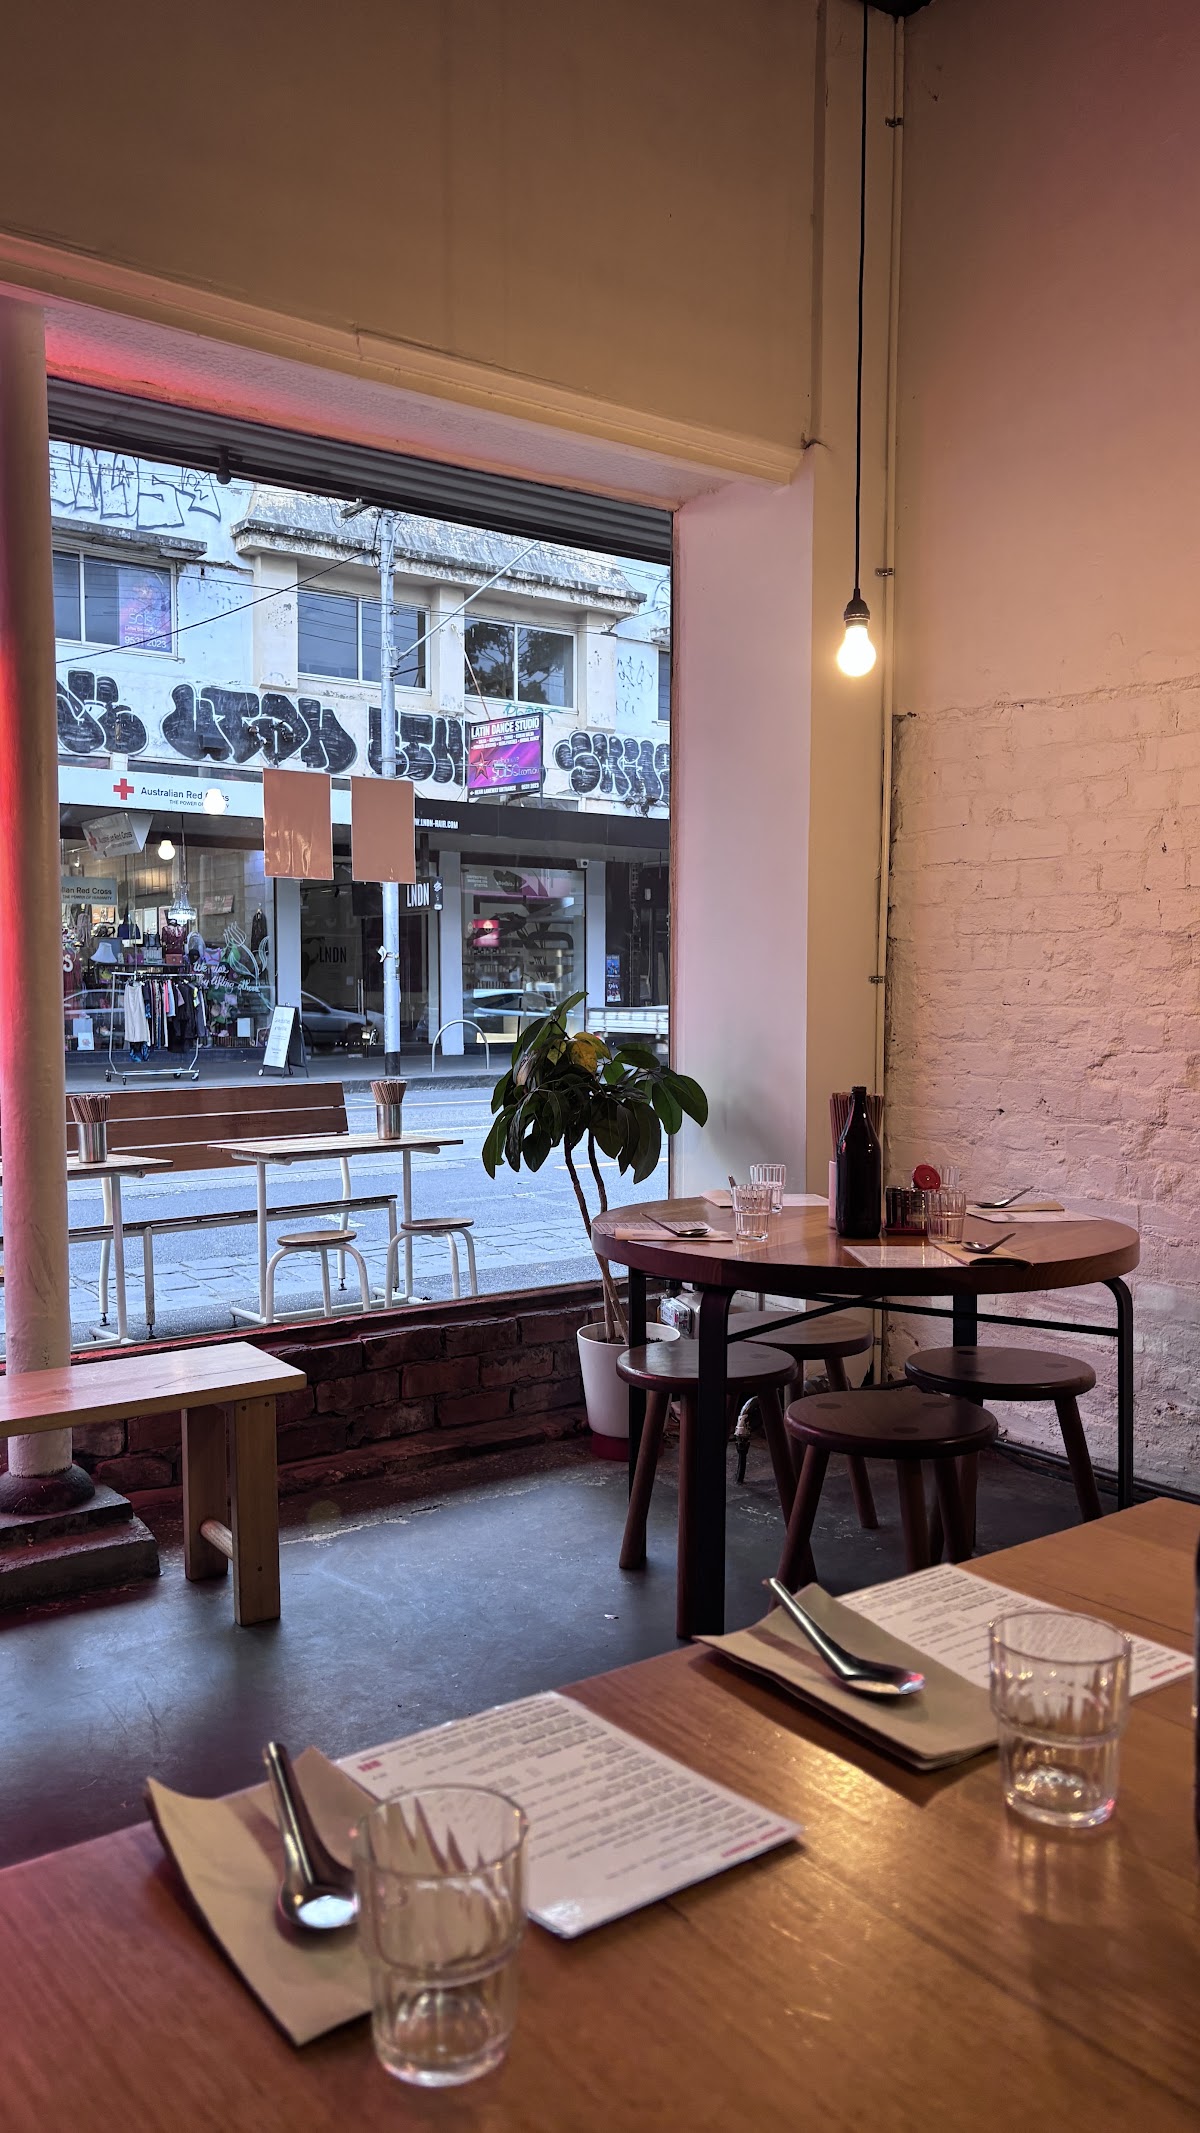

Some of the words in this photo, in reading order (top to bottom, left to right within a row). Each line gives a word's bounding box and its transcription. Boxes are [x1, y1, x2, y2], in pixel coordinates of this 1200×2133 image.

[471, 725, 490, 738] LATIN
[492, 722, 514, 735] DANCE
[515, 718, 540, 731] STUDIO
[140, 787, 184, 798] Australian
[186, 791, 203, 800] Red
[406, 882, 430, 908] LNDN
[319, 946, 347, 963] LNDN
[193, 962, 207, 972] We
[211, 974, 235, 993] lifting
